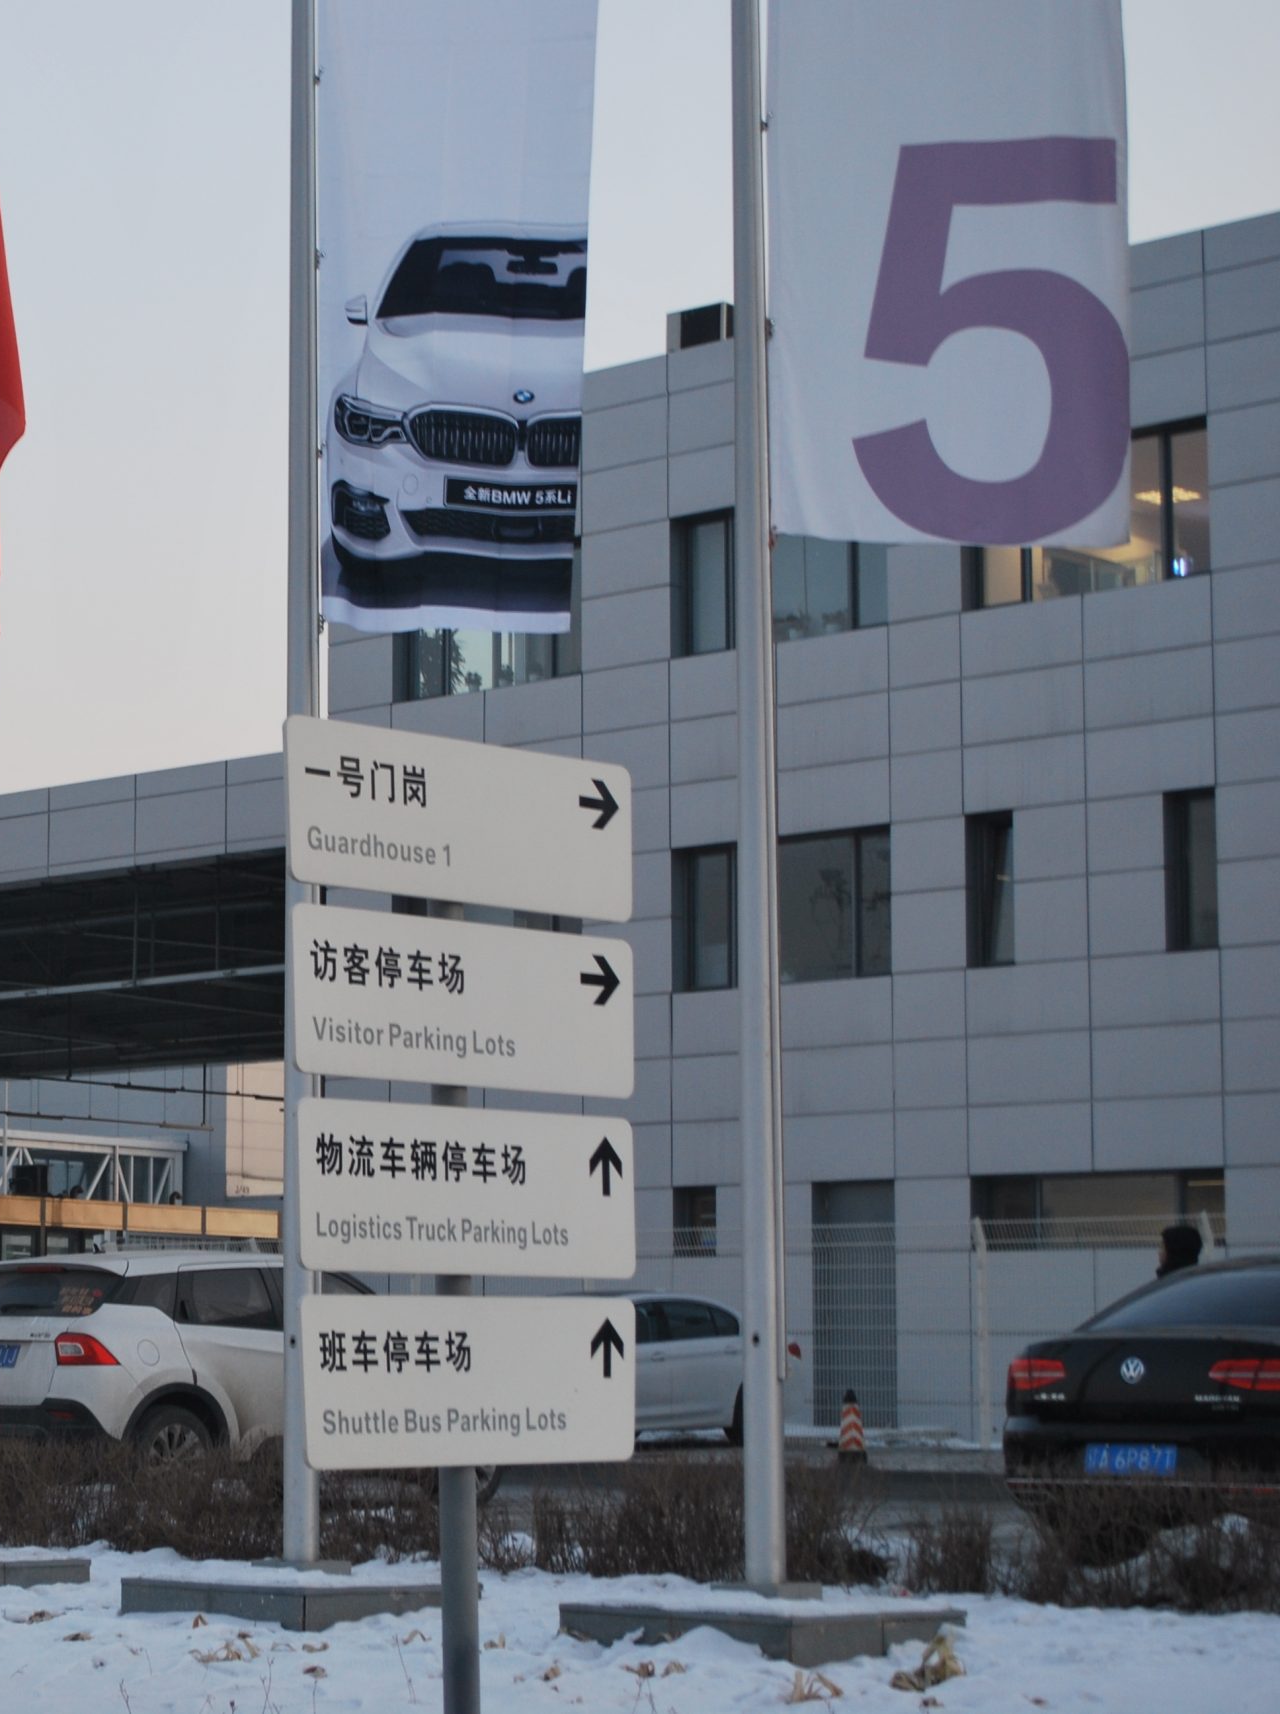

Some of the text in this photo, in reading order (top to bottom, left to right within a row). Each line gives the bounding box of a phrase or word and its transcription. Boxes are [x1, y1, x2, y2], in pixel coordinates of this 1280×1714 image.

[852, 136, 1130, 545] 5
[304, 755, 428, 808] 一号门岗
[307, 826, 452, 867] Guardhouse 1
[310, 938, 465, 995] 访客停车场
[312, 1016, 516, 1058] Visitor Parking Lots
[315, 1132, 527, 1186] 物流车辆停车场
[316, 1212, 569, 1250] Logistics Truck Parking Lots
[318, 1329, 472, 1374] 班车停车场
[322, 1406, 567, 1437] Shuttle Bus Parking Lots
